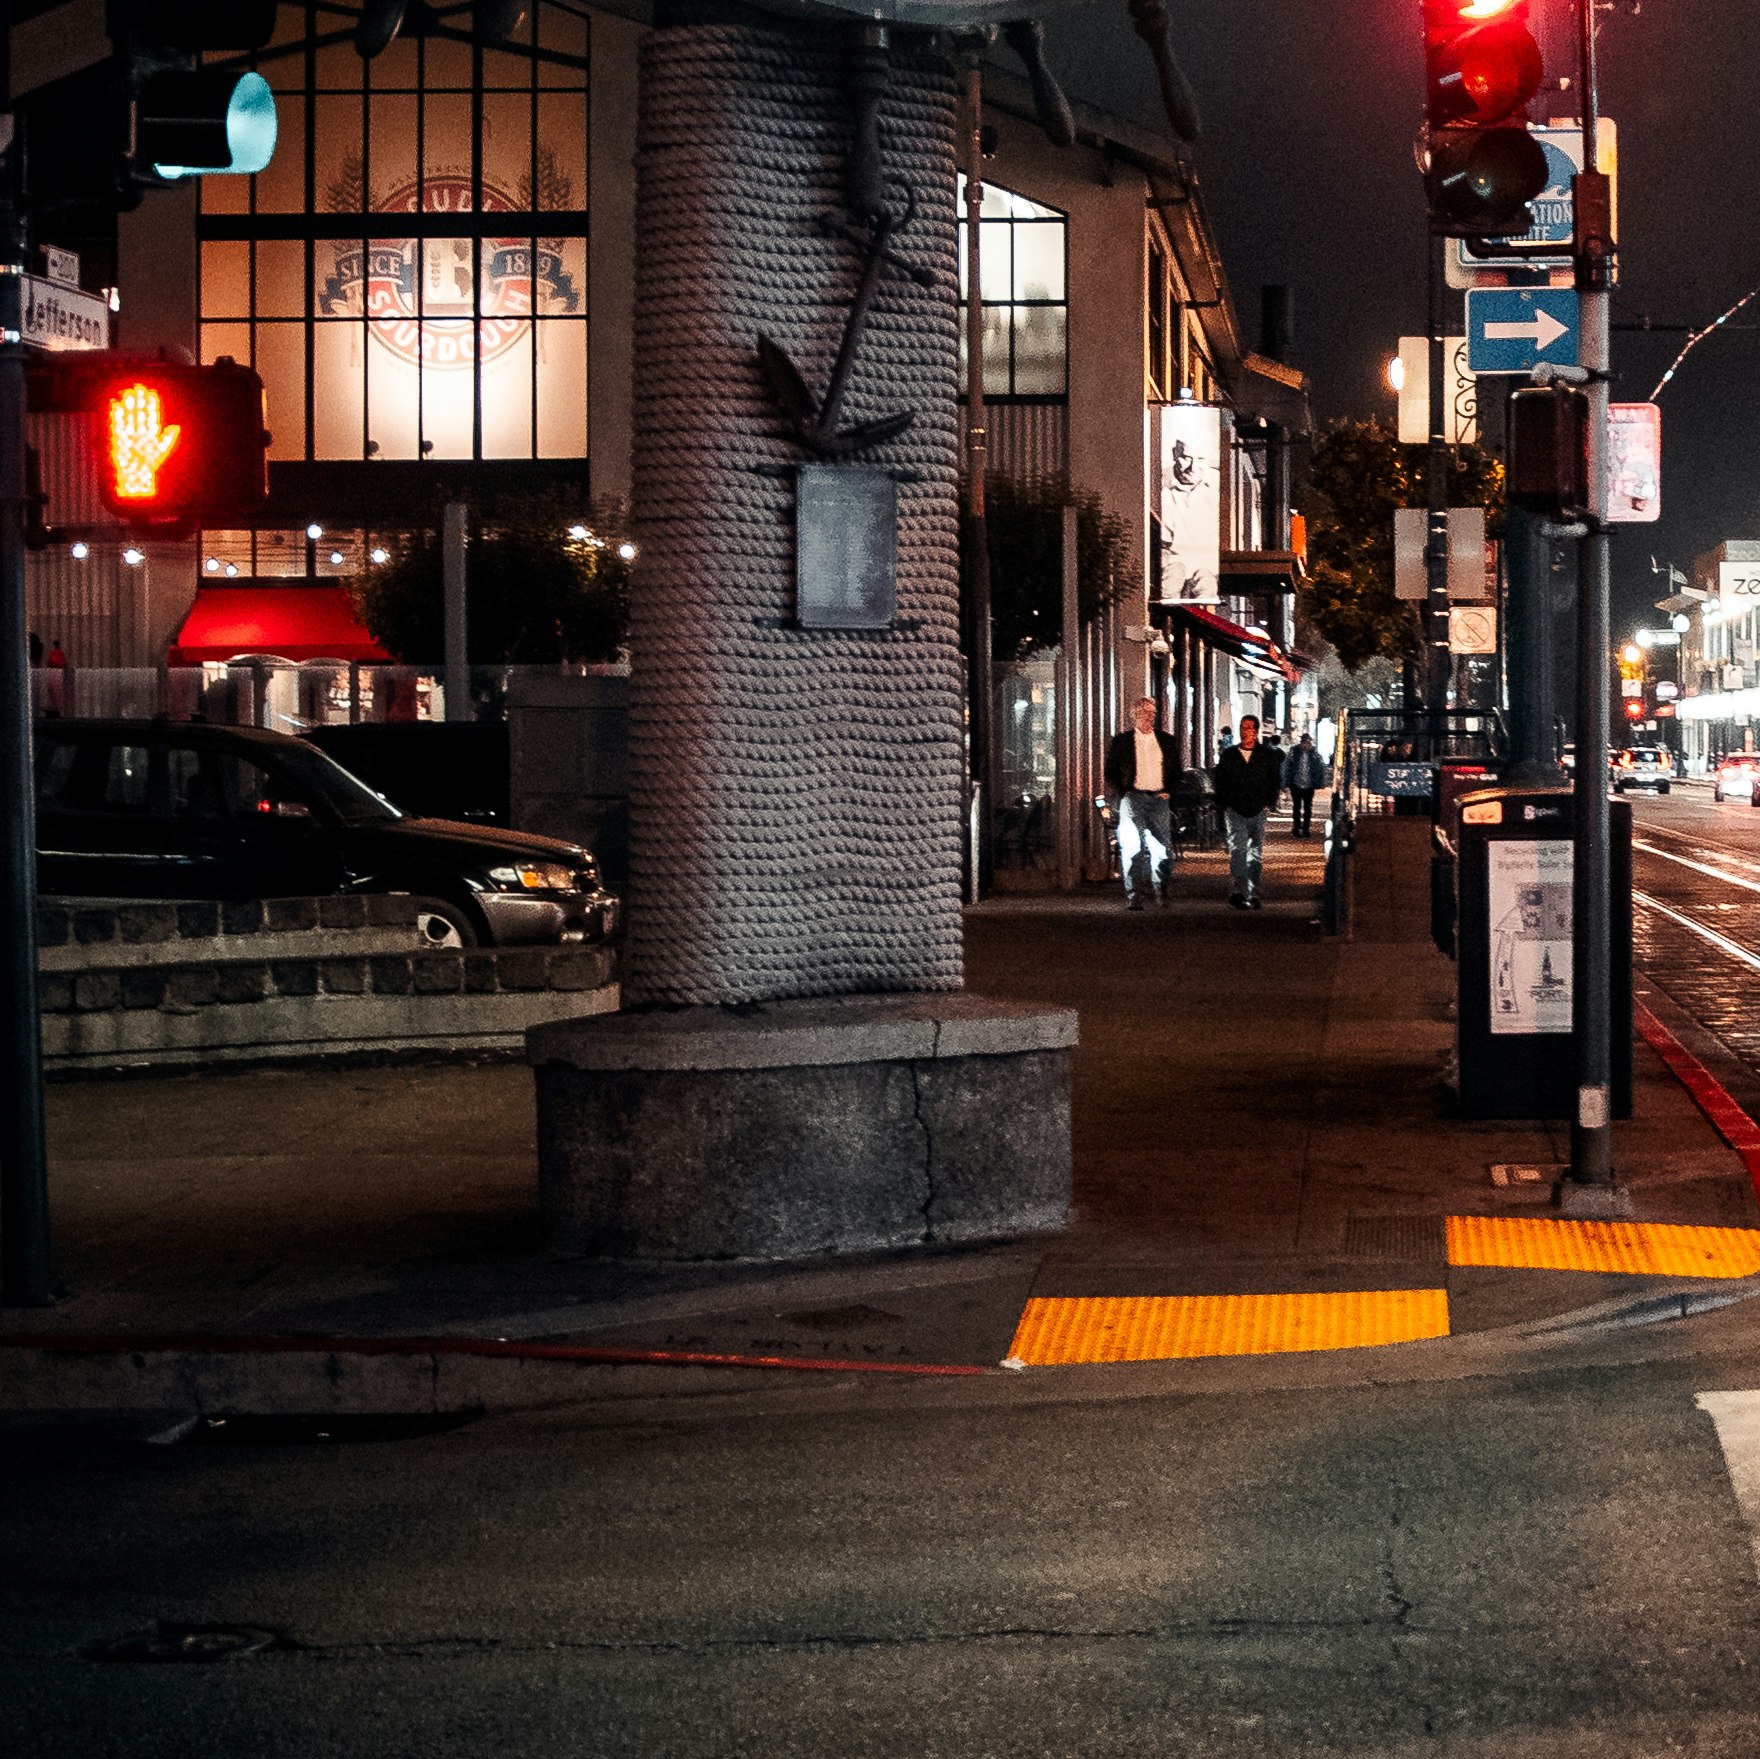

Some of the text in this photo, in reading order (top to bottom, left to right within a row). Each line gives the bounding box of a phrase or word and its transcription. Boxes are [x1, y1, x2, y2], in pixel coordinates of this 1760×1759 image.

[505, 253, 550, 276] 189
[25, 277, 102, 347] Jefferson
[368, 288, 530, 363] SOURDOUGH
